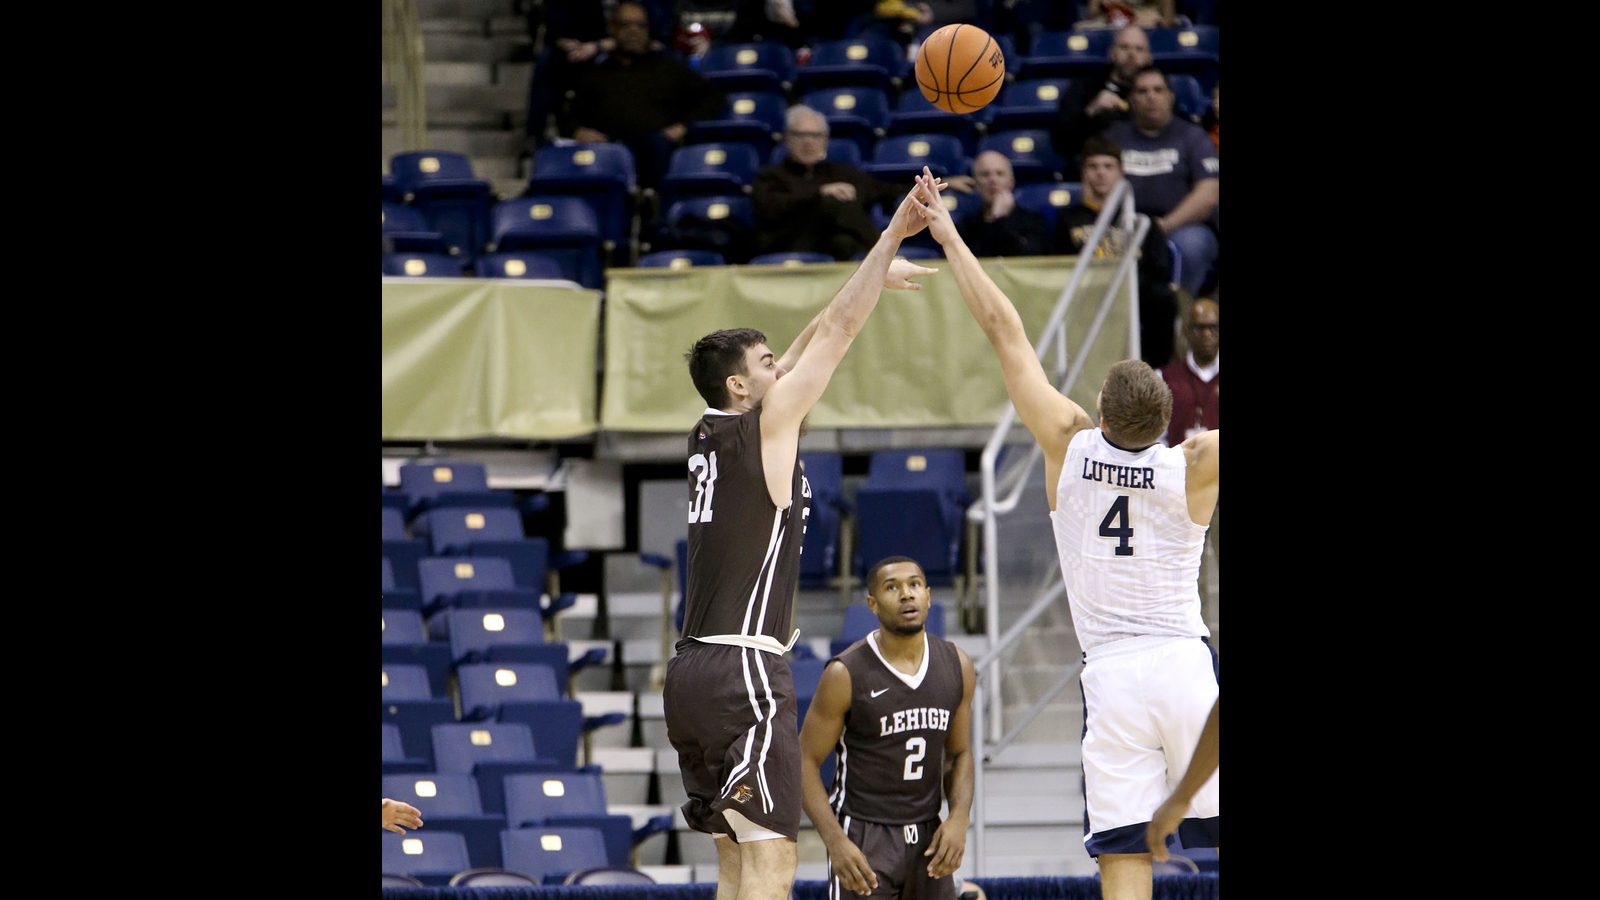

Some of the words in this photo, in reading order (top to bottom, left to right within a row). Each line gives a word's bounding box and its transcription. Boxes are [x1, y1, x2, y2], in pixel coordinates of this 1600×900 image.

[688, 450, 718, 524] 31
[1082, 457, 1155, 490] LUTHER
[1098, 495, 1135, 556] 4
[880, 707, 950, 737] LEHIGH
[903, 737, 927, 780] 2
